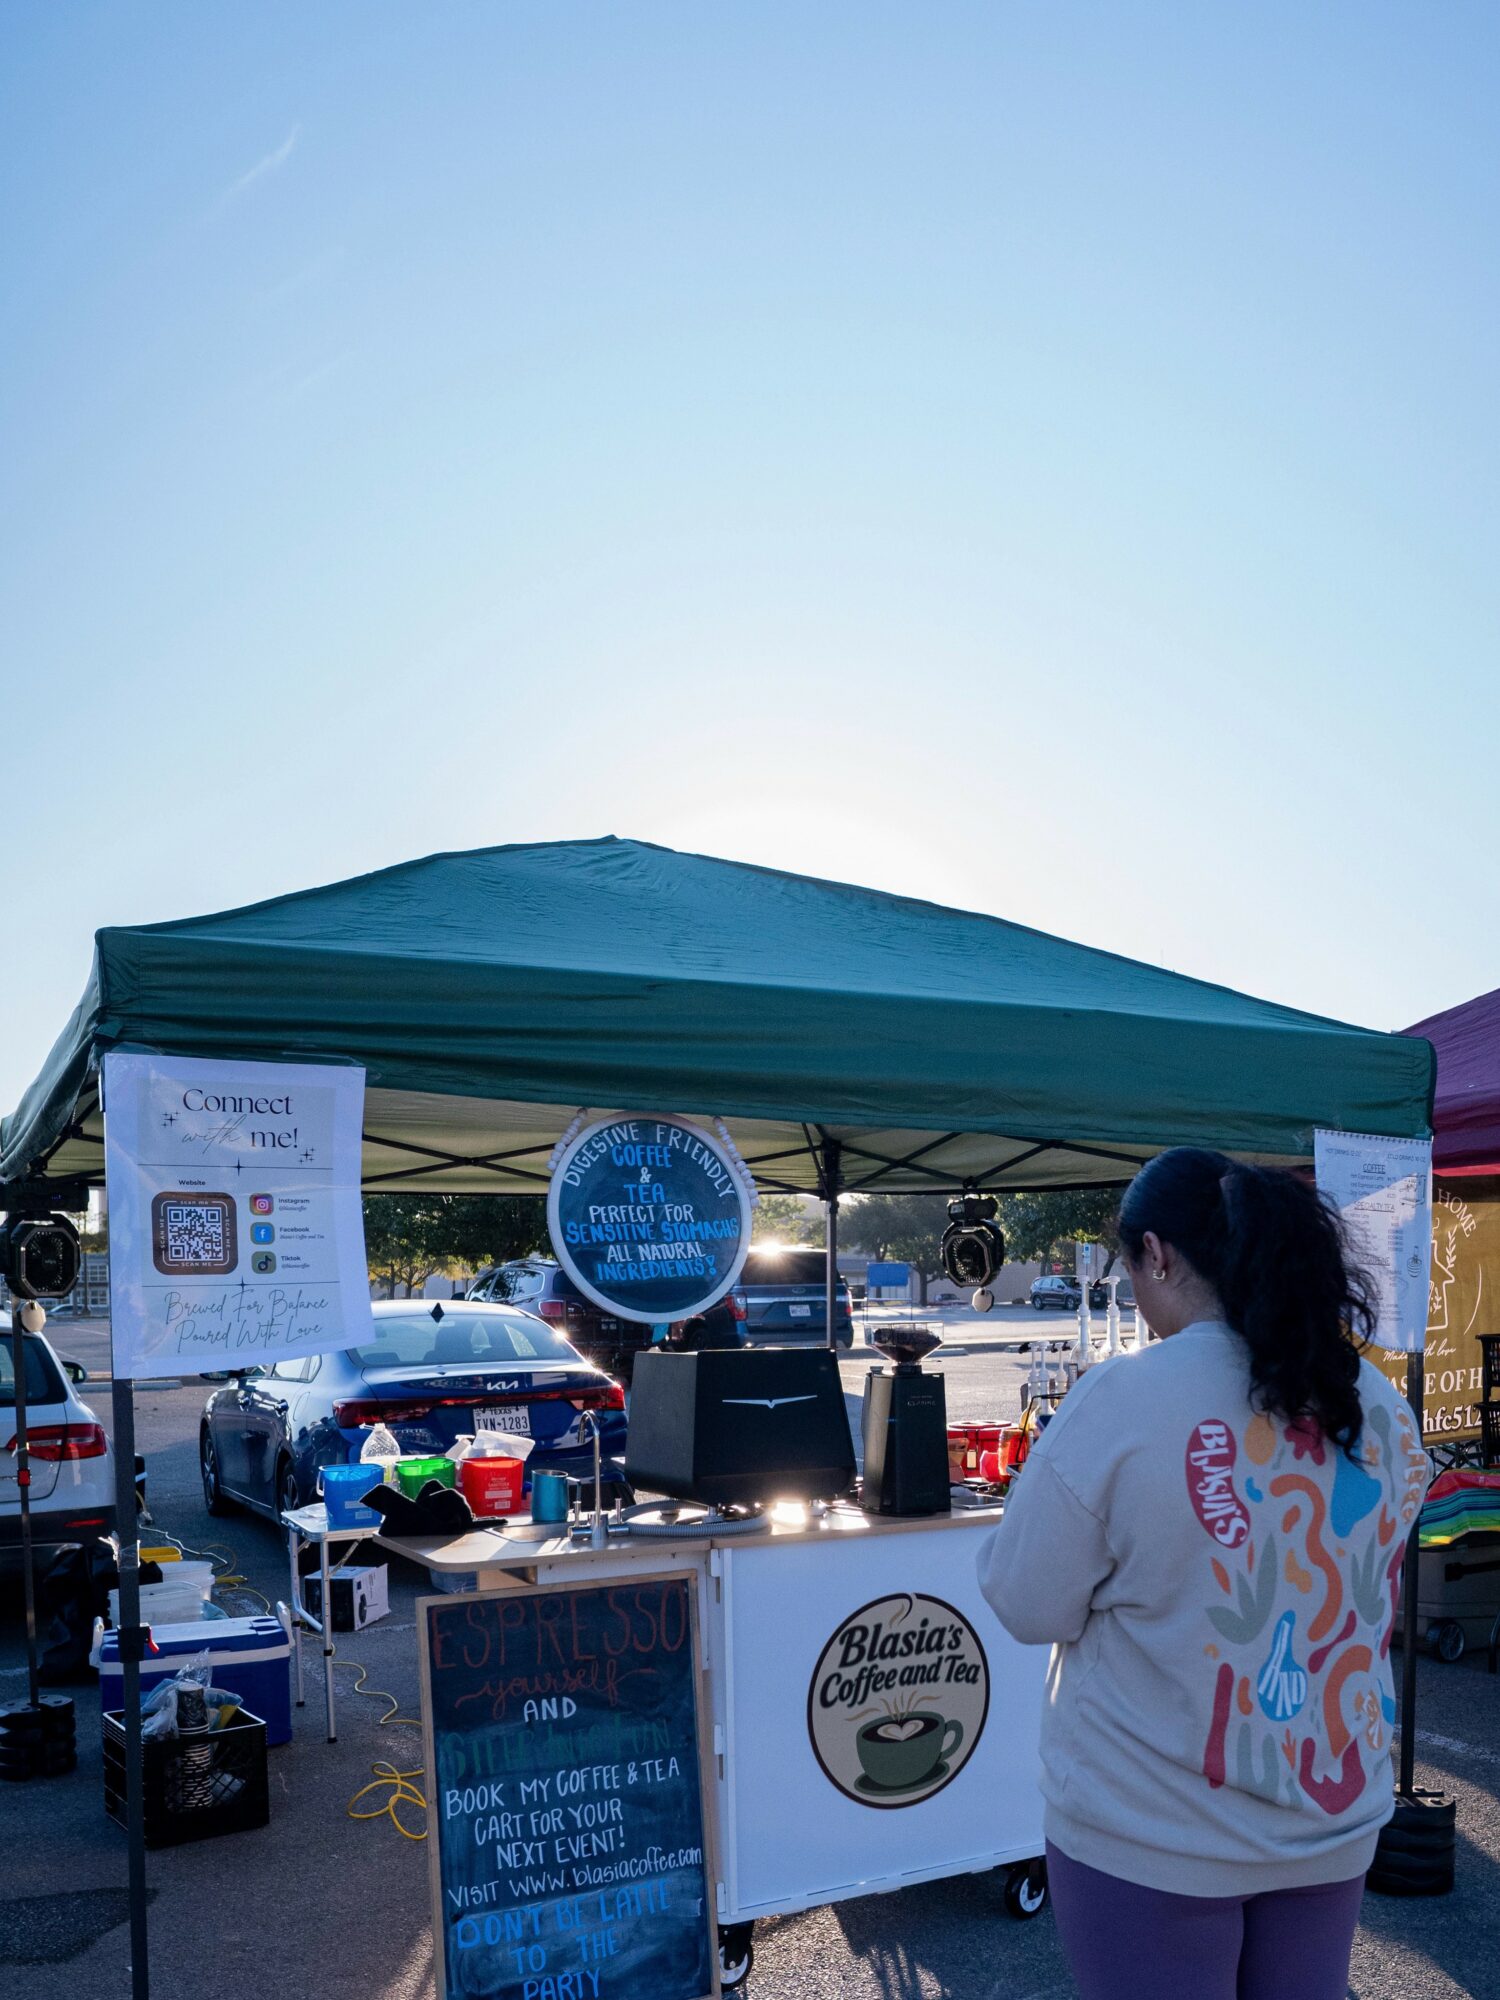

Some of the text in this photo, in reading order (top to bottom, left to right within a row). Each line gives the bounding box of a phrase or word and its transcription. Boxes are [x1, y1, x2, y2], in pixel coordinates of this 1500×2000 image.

[183, 1088, 294, 1115] Connect
[182, 1114, 298, 1154] with me!
[564, 1122, 640, 1186] DIGESTIVE
[612, 1144, 672, 1168] COFFEE
[656, 1124, 736, 1198] FRIENDLY
[1362, 1163, 1386, 1173] COFFEE
[640, 1166, 652, 1184] &
[624, 1184, 666, 1204] TEA
[565, 1217, 739, 1244] SENSITIVE STOMACHS
[588, 1204, 694, 1224] PERFECT FOR
[1438, 1188, 1476, 1238] HOME
[596, 1256, 717, 1281] INGREDIENTS!
[607, 1241, 707, 1263] ALL NATURAL
[164, 1288, 329, 1325] Brewed For Balance
[174, 1315, 324, 1354] Poured With Love
[1436, 1338, 1456, 1356] love
[486, 1380, 518, 1391] KIA
[1440, 1369, 1466, 1393] OF
[490, 1408, 512, 1416] TEXAS
[1189, 1424, 1250, 1547] BLASIA'S
[431, 1580, 688, 1670] ESPRESSO
[838, 1617, 964, 1669] Blasia's
[819, 1654, 982, 1709] Coffee and Tea
[1258, 1620, 1308, 1718] AND
[454, 1658, 658, 1720] yourself
[524, 1696, 578, 1723] AND
[446, 1756, 680, 1820] BOOK MY COFFEE & TEA
[474, 1798, 624, 1846] CART FOR YOUR
[496, 1825, 626, 1870] NEXT EVENT!
[448, 1880, 500, 1908] VISIT
[456, 1880, 672, 1951] DON'T BE LATTE
[510, 1928, 620, 1975] TO THE
[522, 1967, 600, 2000] PARTY
